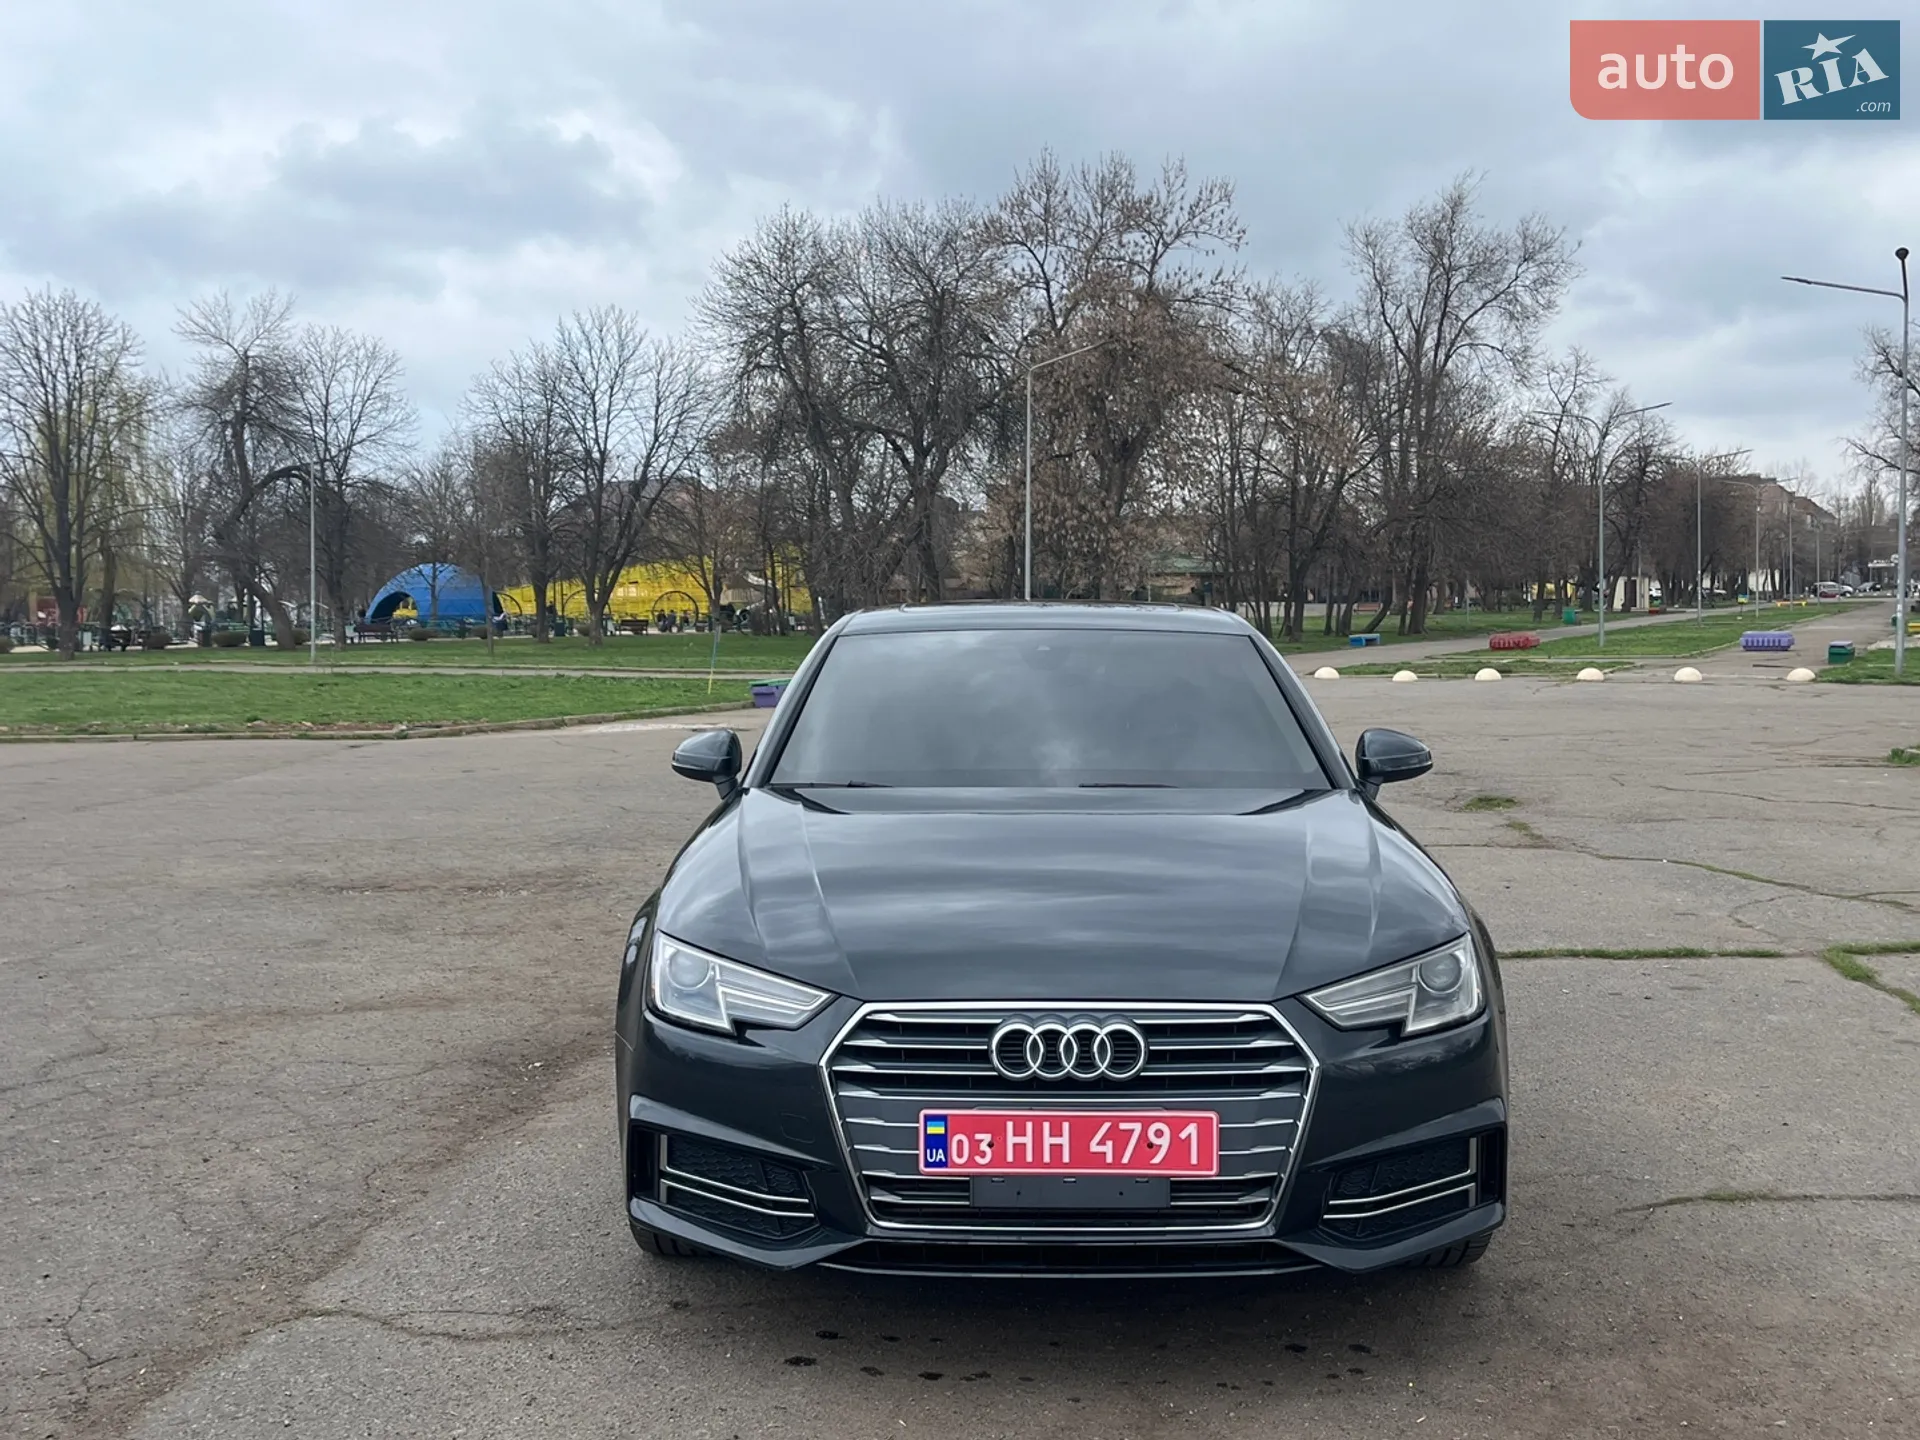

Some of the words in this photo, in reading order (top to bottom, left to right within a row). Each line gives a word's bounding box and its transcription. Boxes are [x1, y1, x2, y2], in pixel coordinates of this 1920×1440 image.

[926, 1149, 945, 1163] UA
[951, 1133, 993, 1165] 03
[1006, 1121, 1070, 1163] HH
[1089, 1121, 1199, 1165] 4791
